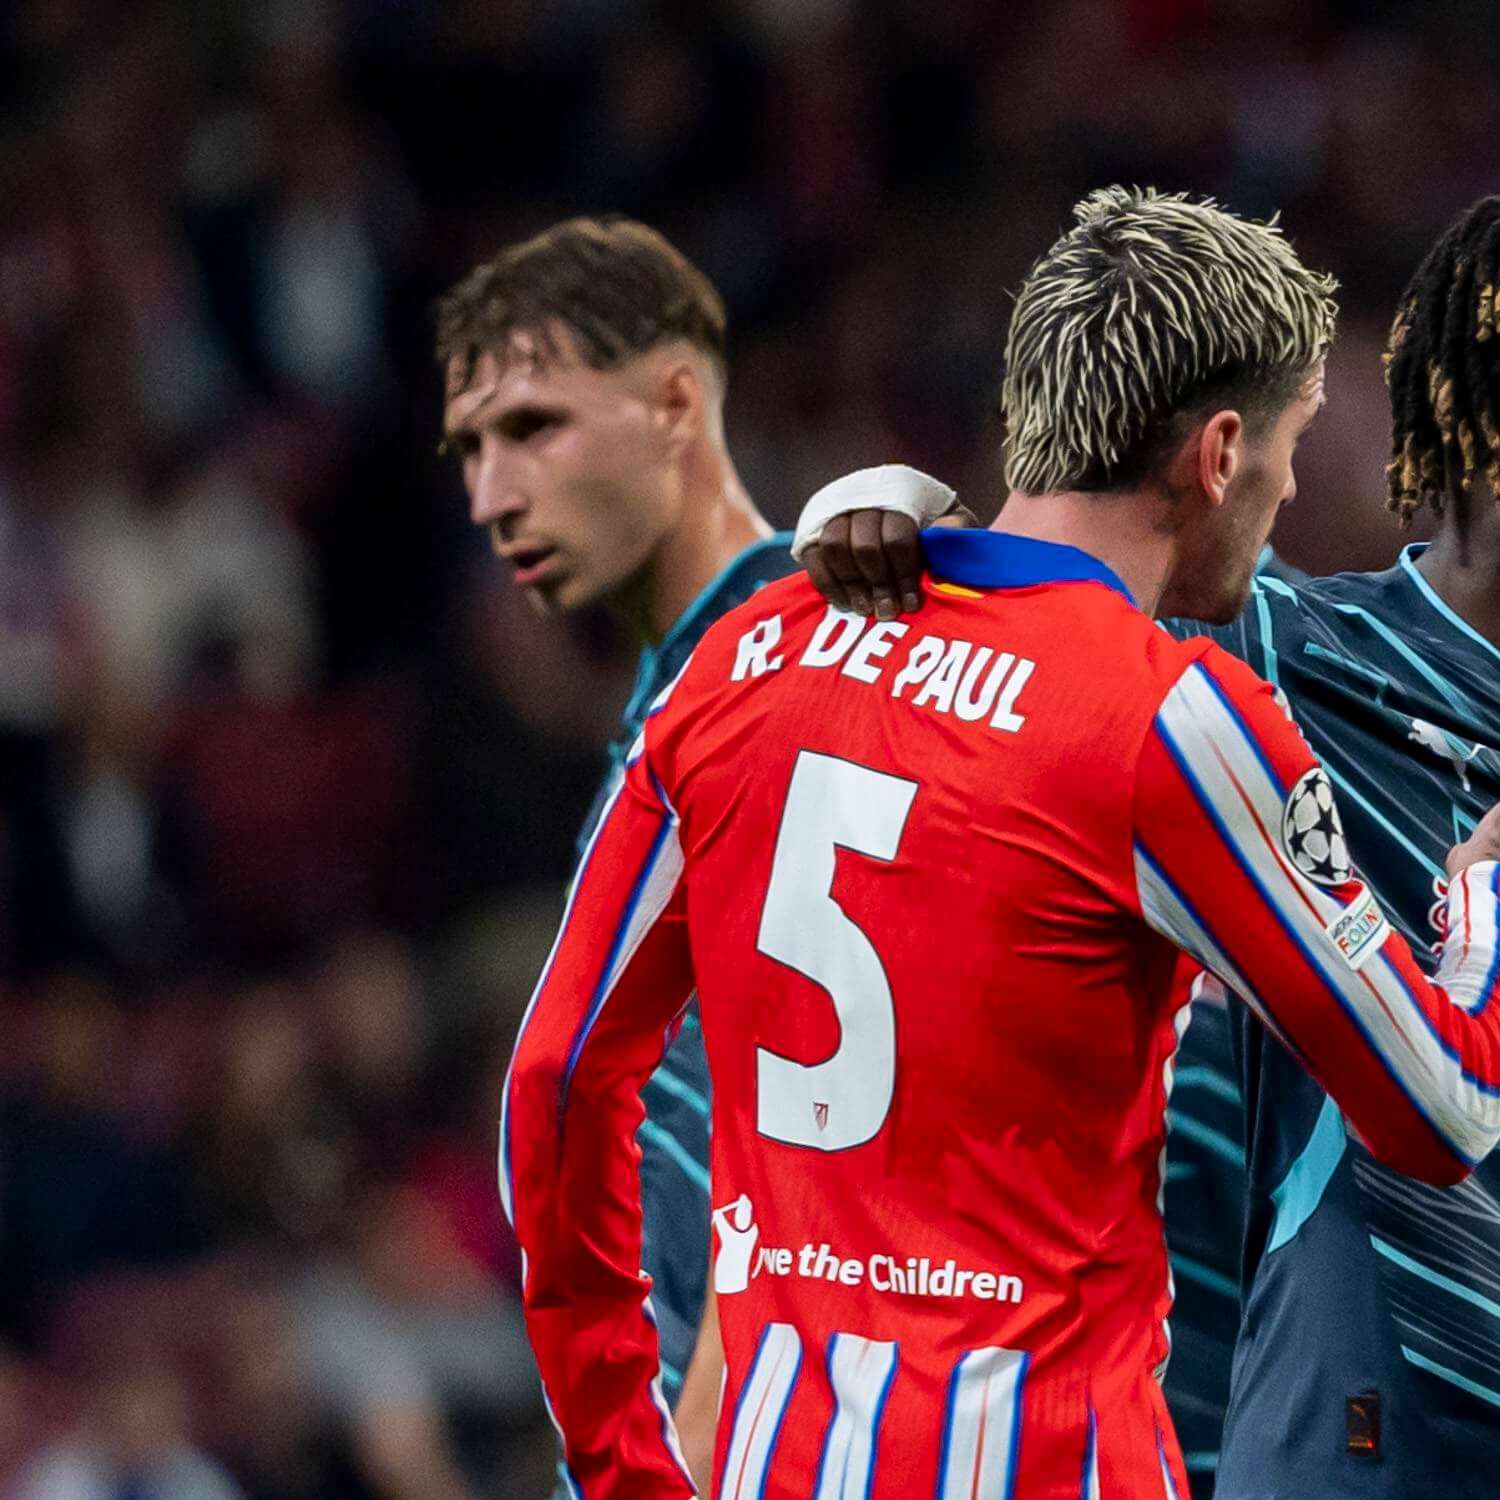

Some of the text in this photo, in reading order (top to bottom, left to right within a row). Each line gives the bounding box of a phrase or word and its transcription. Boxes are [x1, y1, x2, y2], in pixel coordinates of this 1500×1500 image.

[799, 603, 910, 684] DE
[891, 635, 1036, 733] PAUL
[756, 748, 919, 1153] 5
[798, 1244, 864, 1286] the
[868, 1254, 1024, 1304] Children
